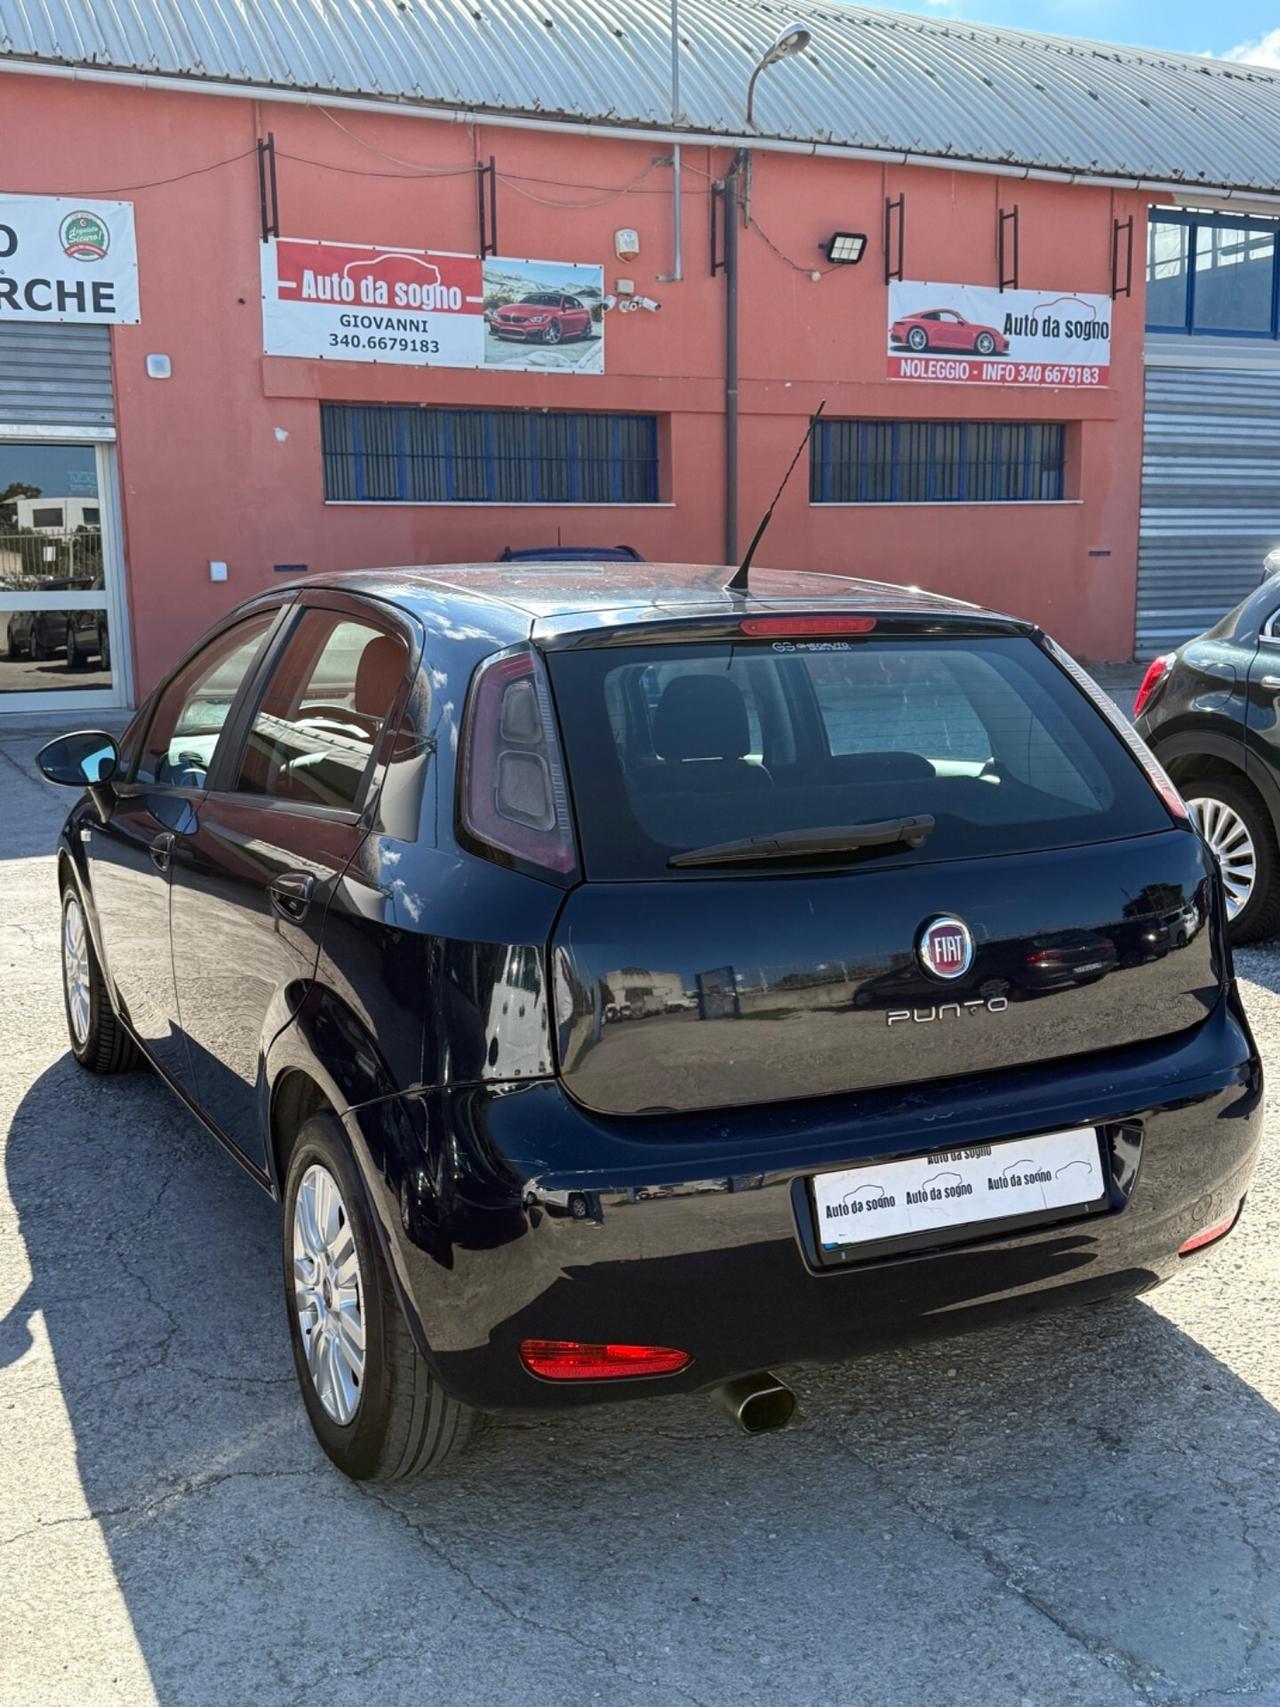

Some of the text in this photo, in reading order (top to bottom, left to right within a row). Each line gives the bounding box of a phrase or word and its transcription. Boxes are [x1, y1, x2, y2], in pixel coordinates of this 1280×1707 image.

[301, 269, 462, 311] Auto da sogno
[339, 314, 429, 333] GIOVANNI
[1003, 313, 1109, 341] Auto da sogno
[329, 333, 440, 354] 340.6679183
[900, 359, 970, 379] NOLEGGIO
[982, 363, 1015, 382] INFO
[1018, 365, 1041, 383] 340
[1044, 366, 1099, 384] 6679183
[934, 936, 962, 963] FIAT
[988, 1176, 1009, 1191] Auto
[1010, 1174, 1022, 1187] da
[906, 1183, 973, 1205] Auto da sogno
[826, 1202, 850, 1219] Auto
[851, 1201, 864, 1214] da
